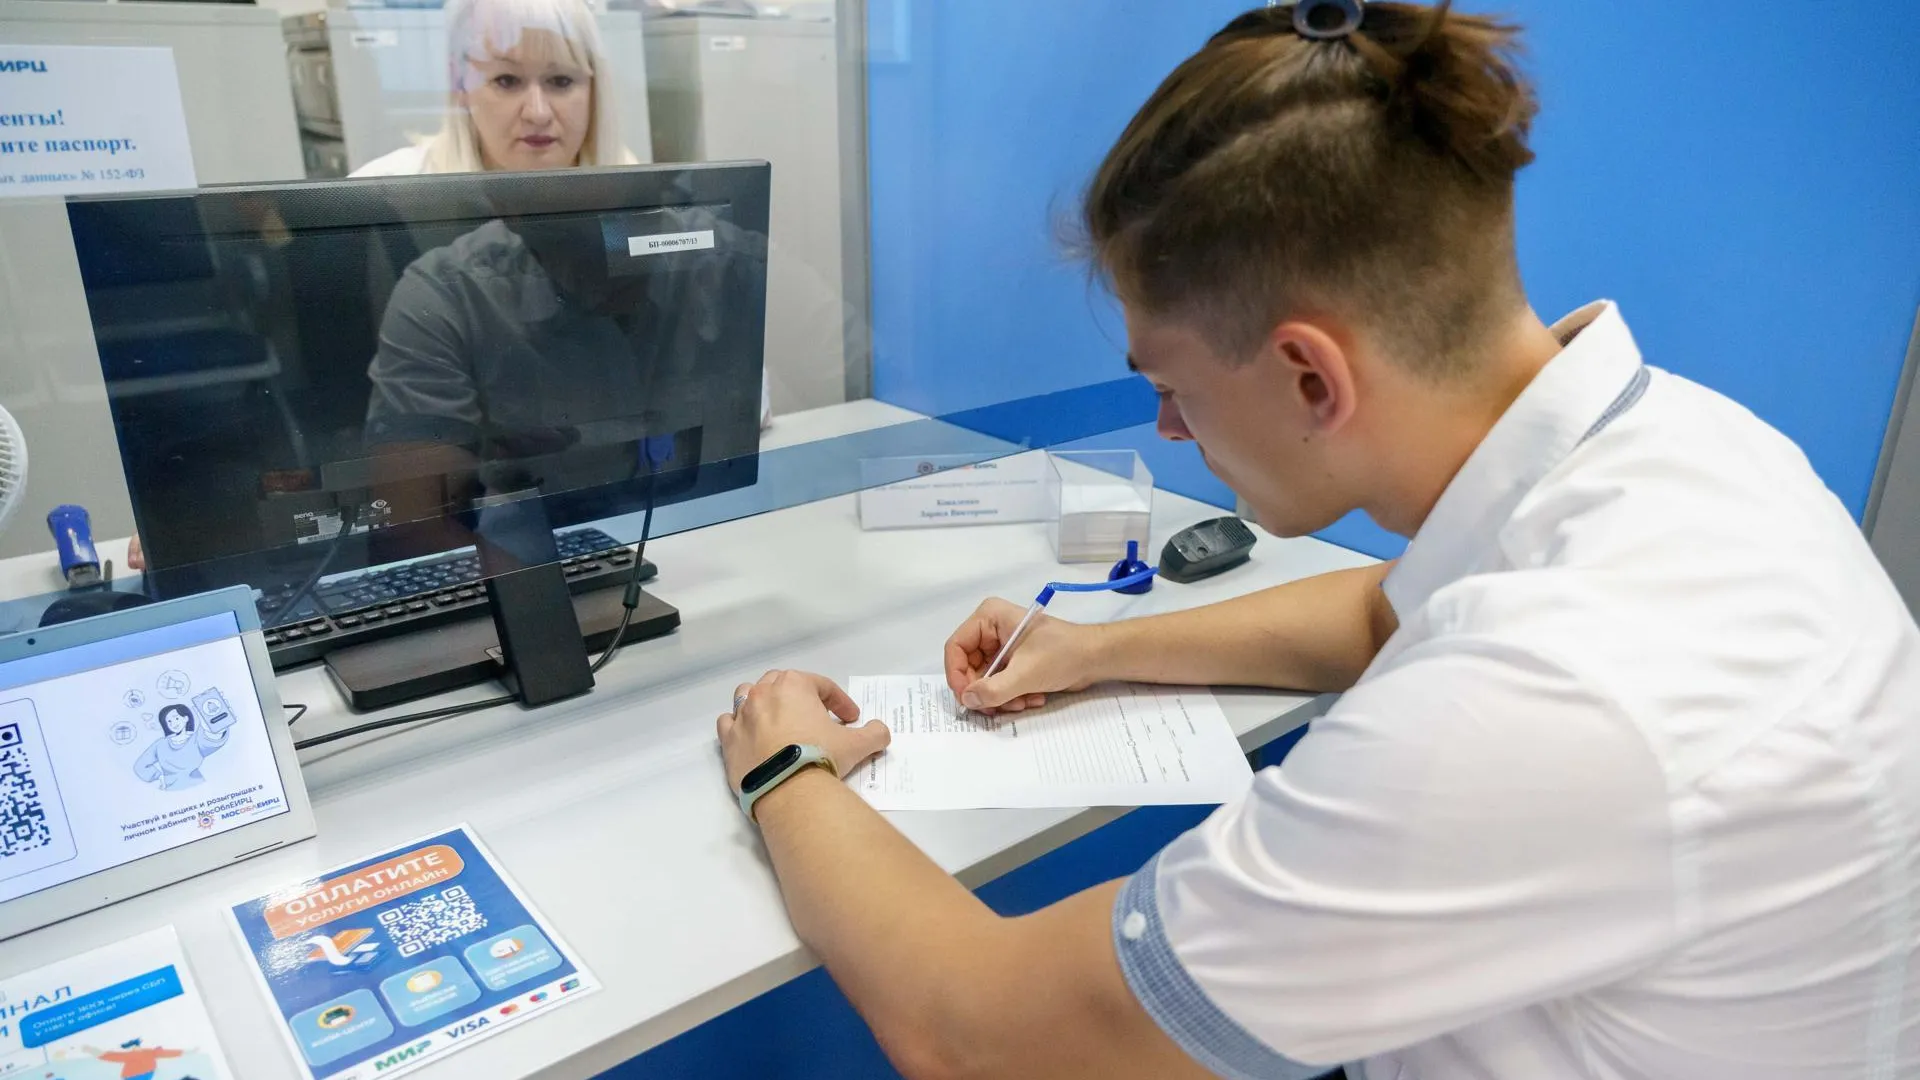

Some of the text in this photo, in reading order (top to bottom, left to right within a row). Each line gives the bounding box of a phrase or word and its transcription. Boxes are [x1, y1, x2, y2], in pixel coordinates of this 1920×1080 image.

[44, 137, 137, 155] паспорт.
[100, 167, 145, 181] 152-ФЗ
[120, 814, 160, 832] Участвуй
[169, 804, 198, 818] акциях
[206, 786, 257, 807] розыгрышах
[123, 827, 157, 842] личном
[158, 814, 197, 831] кабинете
[285, 851, 445, 915] ОПЛАТИТЕ
[296, 867, 449, 926] УСЛУГИ ОНЛАЙН
[445, 1016, 491, 1039] VISA
[374, 1040, 432, 1071] МИР
